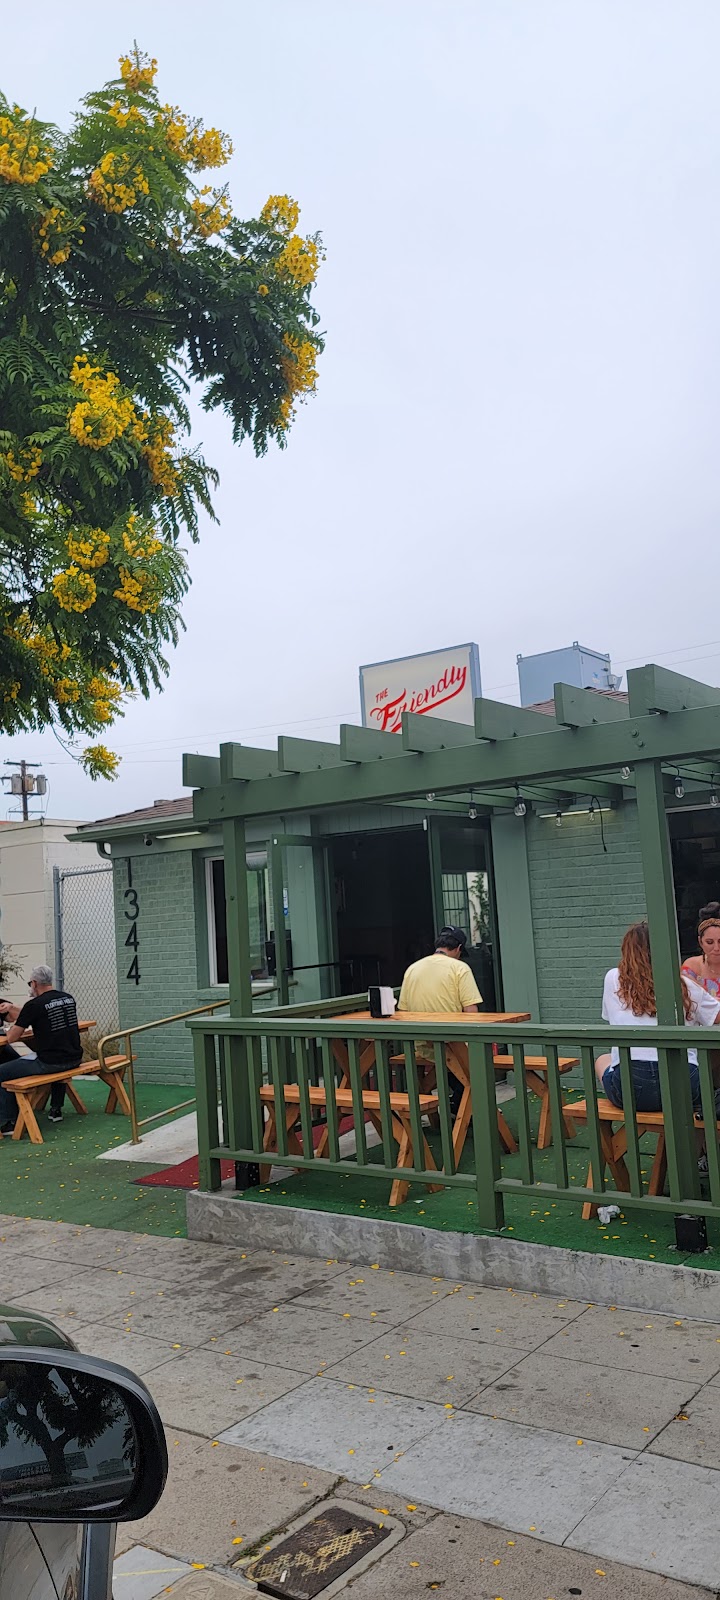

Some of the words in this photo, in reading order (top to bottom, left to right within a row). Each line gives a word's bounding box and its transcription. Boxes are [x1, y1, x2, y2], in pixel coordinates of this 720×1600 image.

[369, 665, 467, 731] Friendly
[375, 687, 388, 703] THE
[124, 857, 141, 986] 1344
